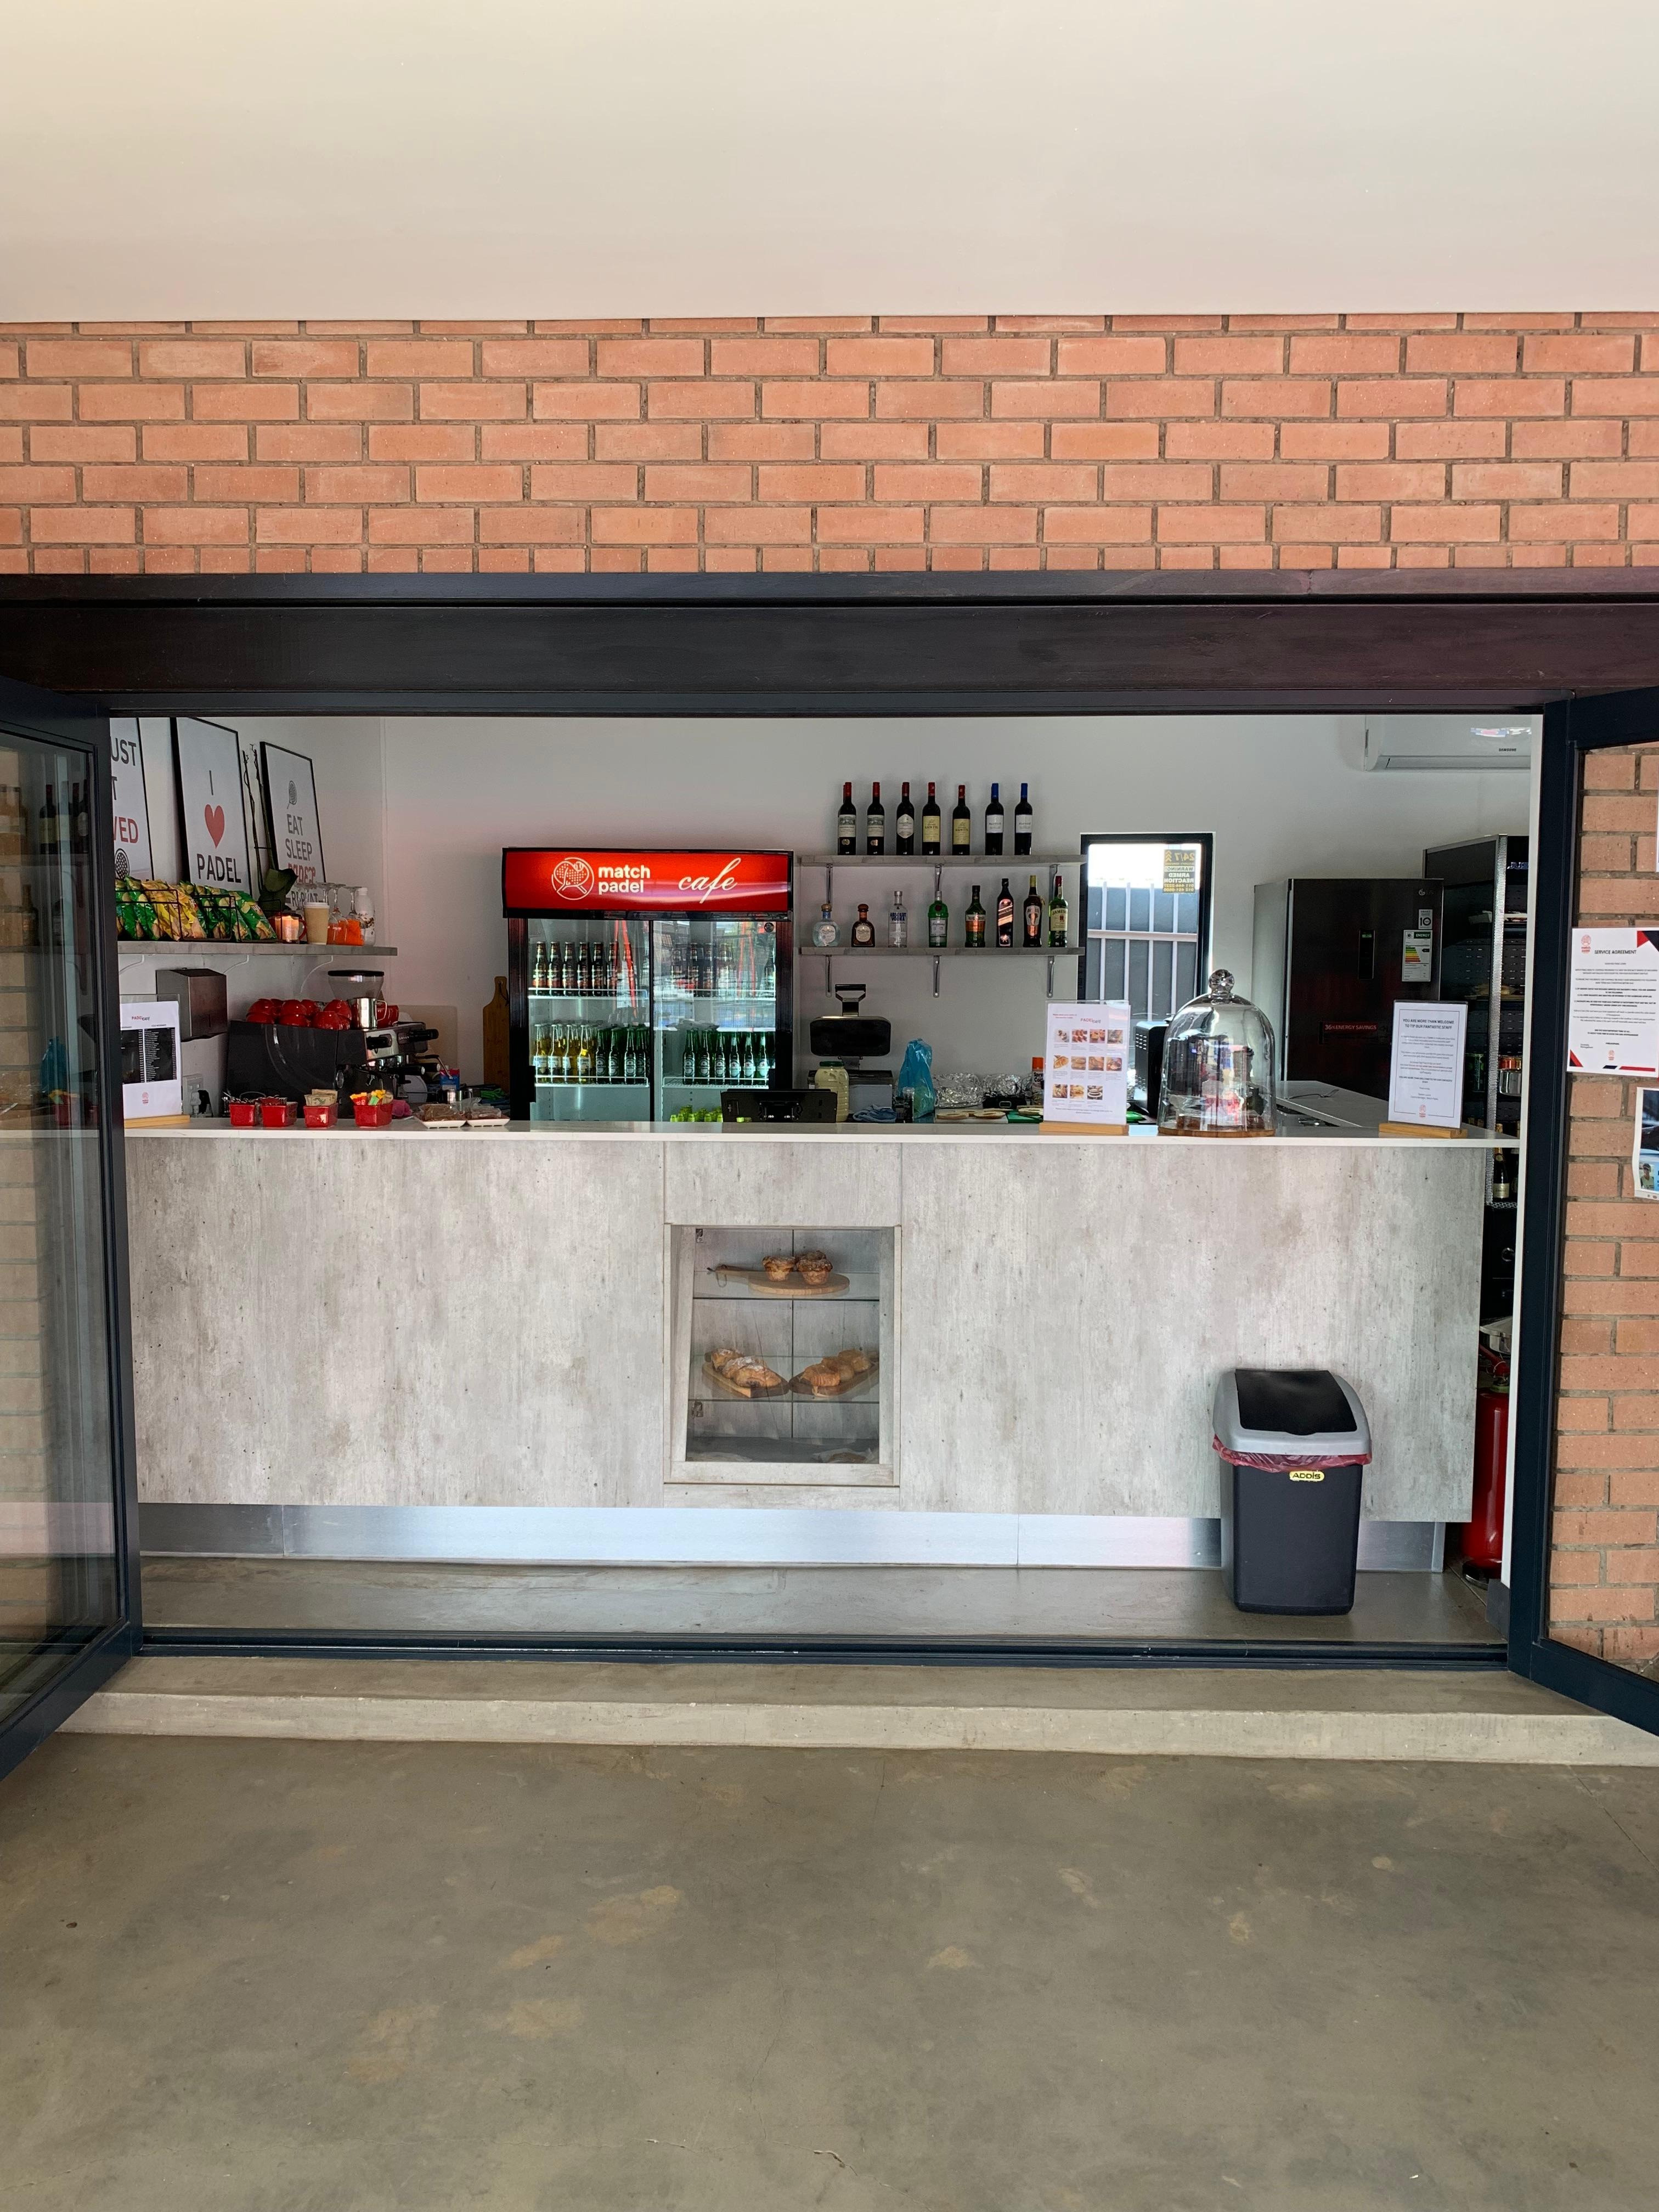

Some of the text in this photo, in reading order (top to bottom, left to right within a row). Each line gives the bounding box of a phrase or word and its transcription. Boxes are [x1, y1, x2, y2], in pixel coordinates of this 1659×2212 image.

[111, 738, 137, 766] UST
[209, 770, 214, 795] I
[287, 814, 303, 836] EAT
[285, 838, 312, 861] SLEEP
[197, 854, 241, 883] PADEL
[598, 865, 650, 879] match
[678, 857, 741, 904] cafe
[598, 879, 644, 895] padel
